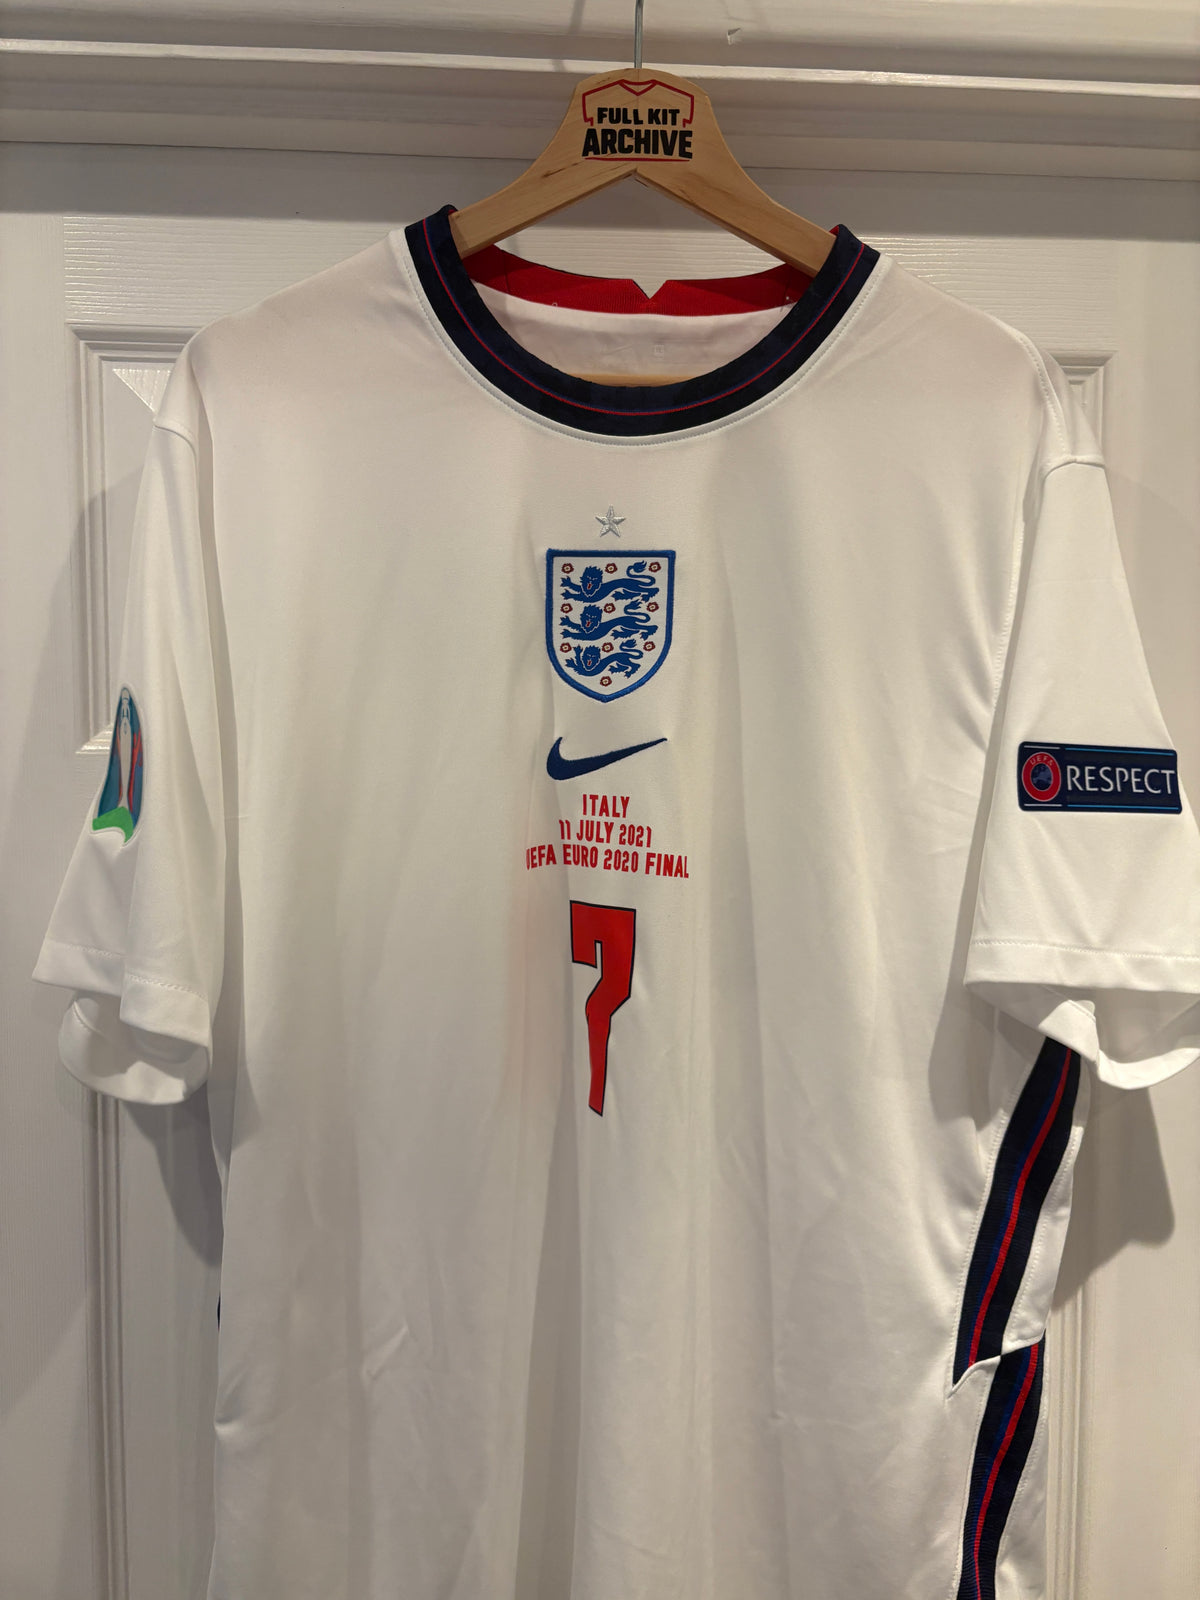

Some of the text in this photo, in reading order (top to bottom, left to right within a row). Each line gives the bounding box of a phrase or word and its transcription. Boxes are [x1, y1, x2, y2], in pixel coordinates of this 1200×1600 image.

[597, 107, 680, 126] FULL KIT
[582, 128, 693, 159] ARCHIVE
[1030, 755, 1054, 766] UEFA
[1066, 765, 1175, 795] RESPECT
[582, 794, 630, 819] ITALY
[558, 819, 652, 848] 11 JULY 2021
[562, 843, 598, 869] EURO
[603, 849, 639, 873] 2020
[645, 852, 689, 879] FINAL
[569, 900, 636, 1117] 7
